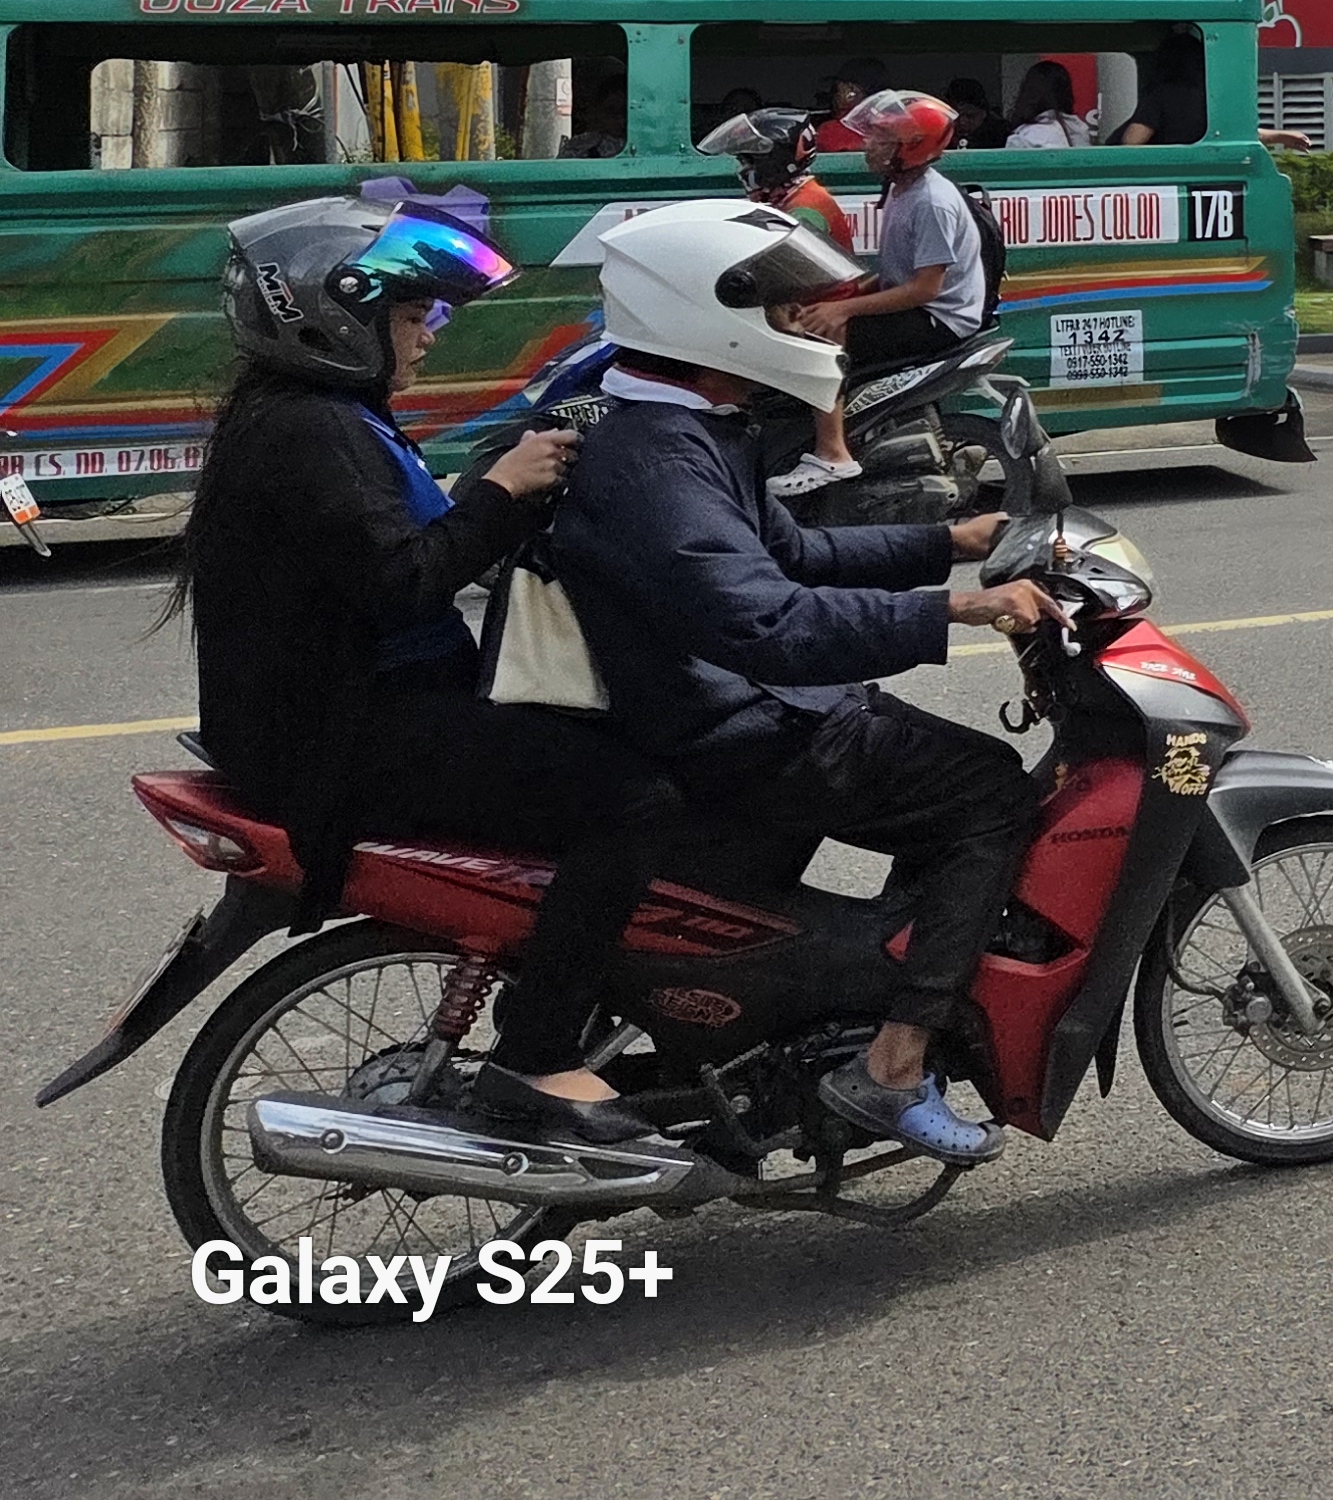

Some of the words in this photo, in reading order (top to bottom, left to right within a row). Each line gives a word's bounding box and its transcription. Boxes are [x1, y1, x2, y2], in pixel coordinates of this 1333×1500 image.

[1036, 194, 1095, 243] JONES
[1101, 192, 1160, 241] COLON
[1191, 190, 1234, 239] 17B
[1068, 329, 1125, 345] 1342
[1165, 733, 1207, 747] HANDS
[1050, 826, 1129, 844] HONDA
[353, 842, 501, 871] WAVE
